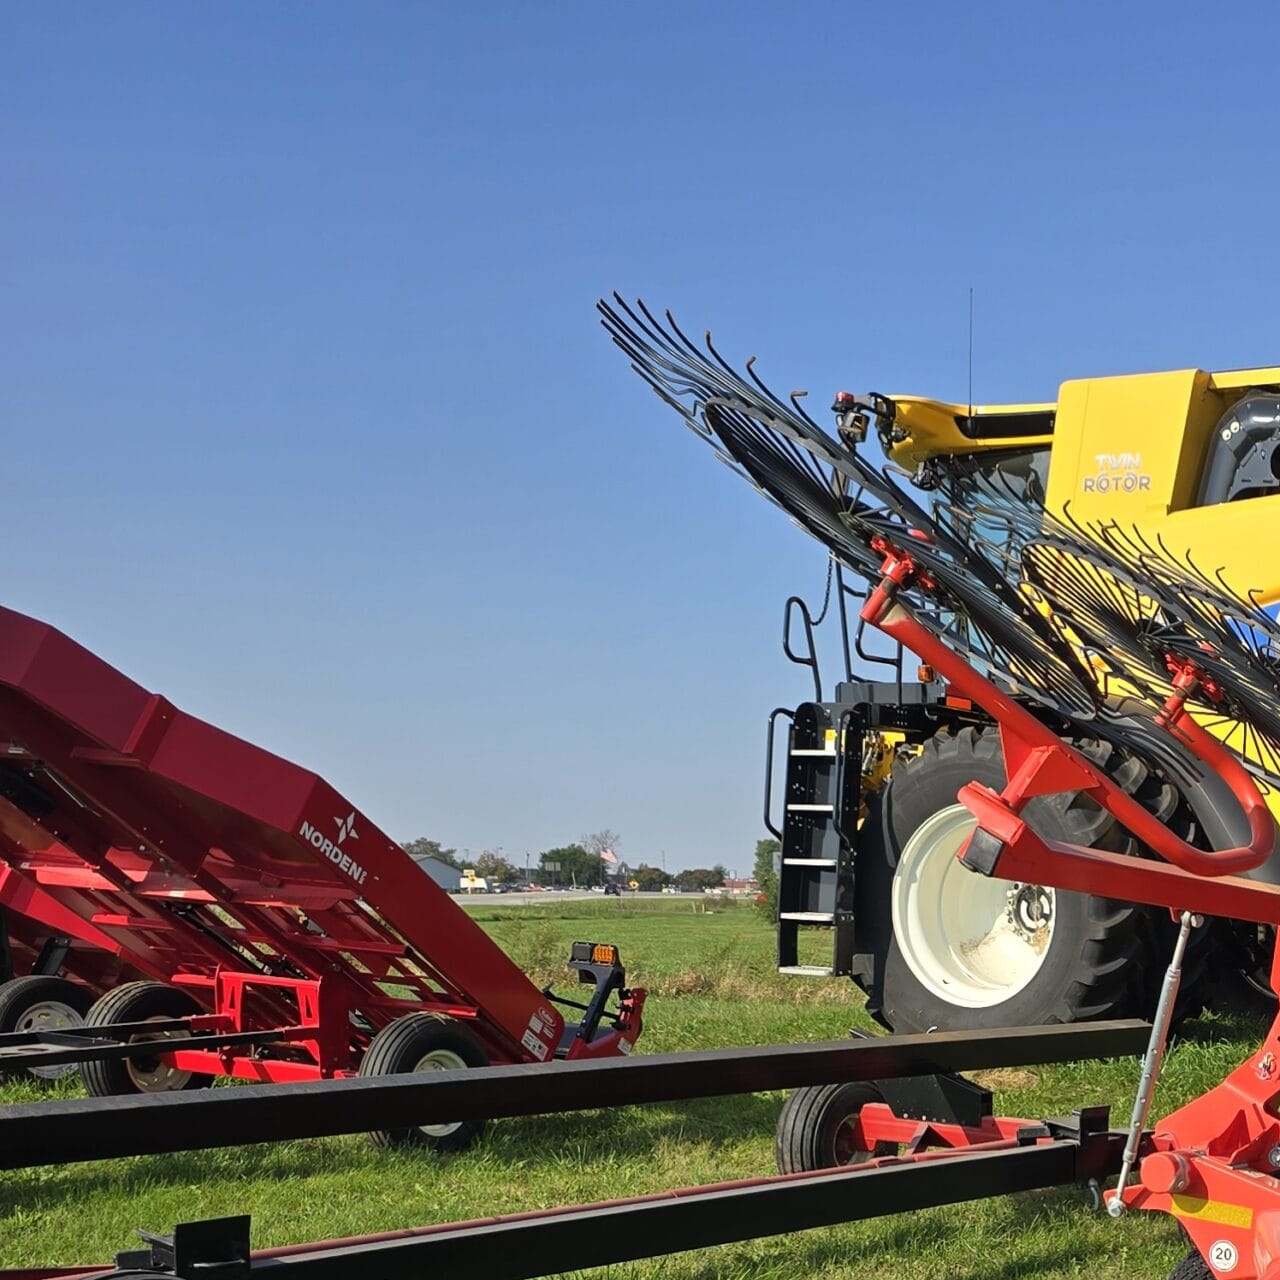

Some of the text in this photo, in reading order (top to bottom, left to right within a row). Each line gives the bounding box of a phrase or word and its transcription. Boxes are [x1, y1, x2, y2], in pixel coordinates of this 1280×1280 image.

[1096, 453, 1141, 470] TWIN
[1084, 472, 1151, 493] ROTOR
[300, 820, 362, 882] NORDEN
[1215, 1247, 1232, 1261] 20
